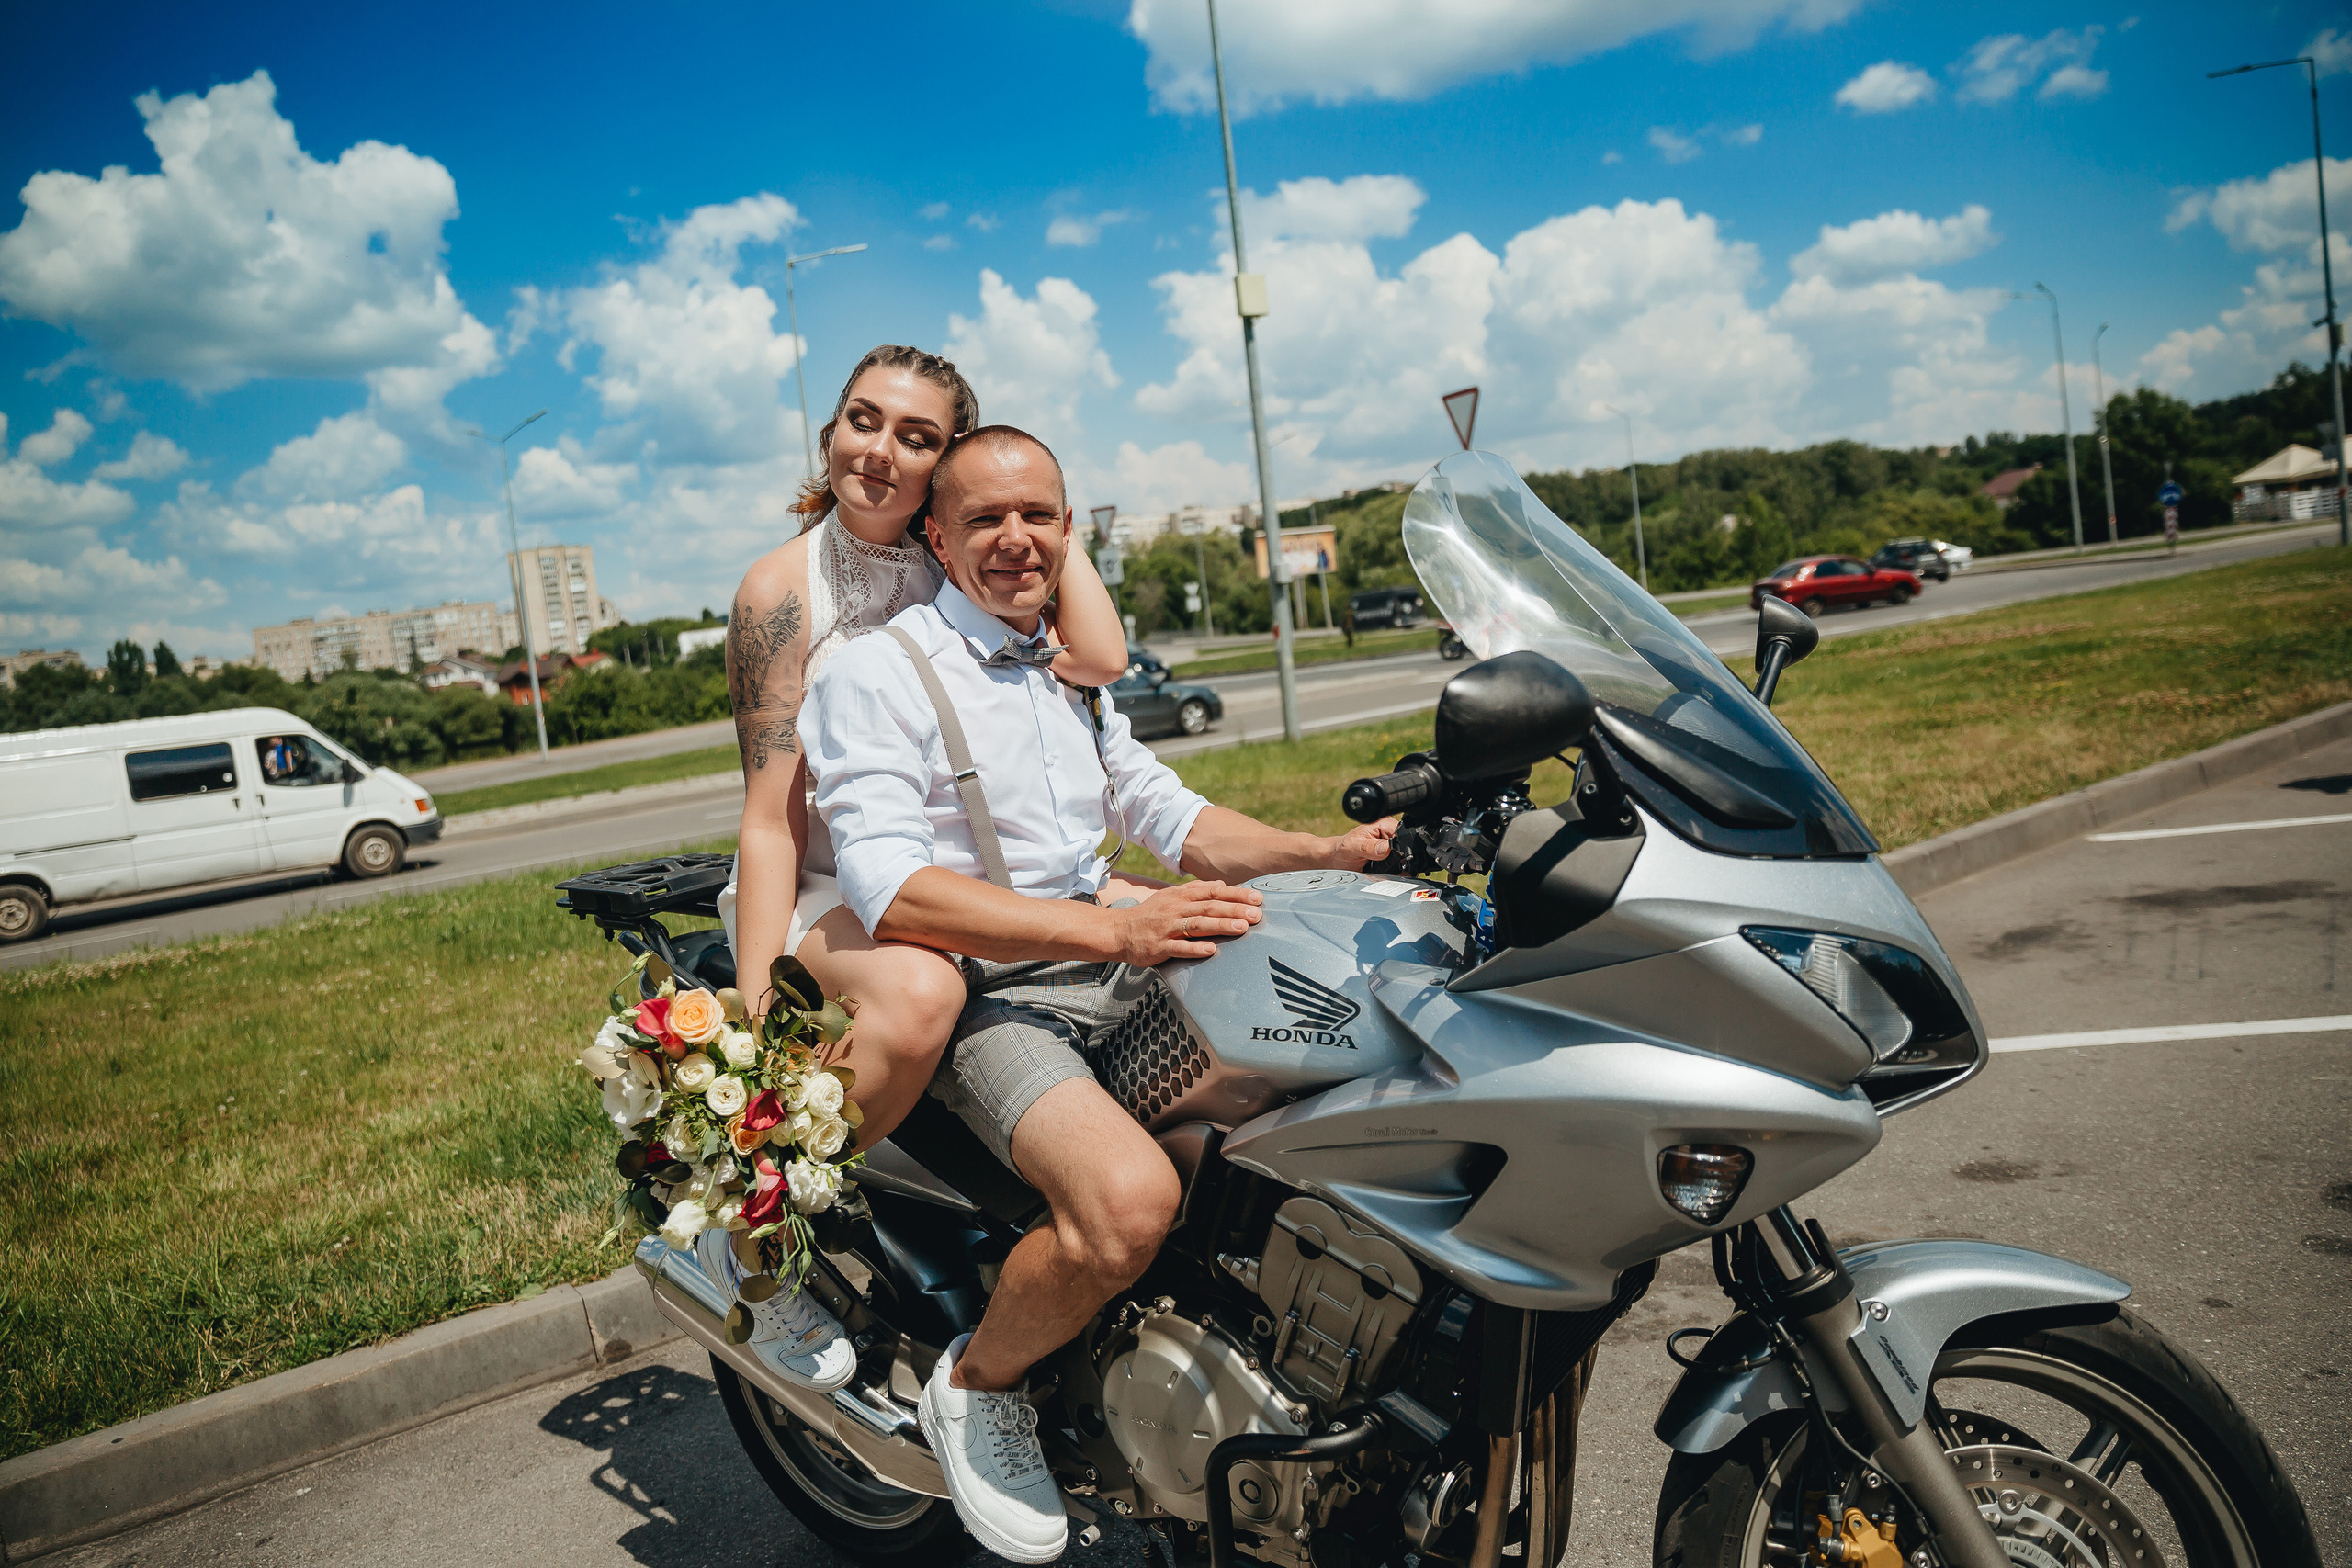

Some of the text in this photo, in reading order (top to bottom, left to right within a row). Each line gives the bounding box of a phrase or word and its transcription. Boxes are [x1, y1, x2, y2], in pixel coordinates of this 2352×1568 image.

[1250, 1027, 1359, 1050] HONDA
[1879, 1335, 1920, 1390] Combined
[1130, 1414, 1177, 1433] HONDA
